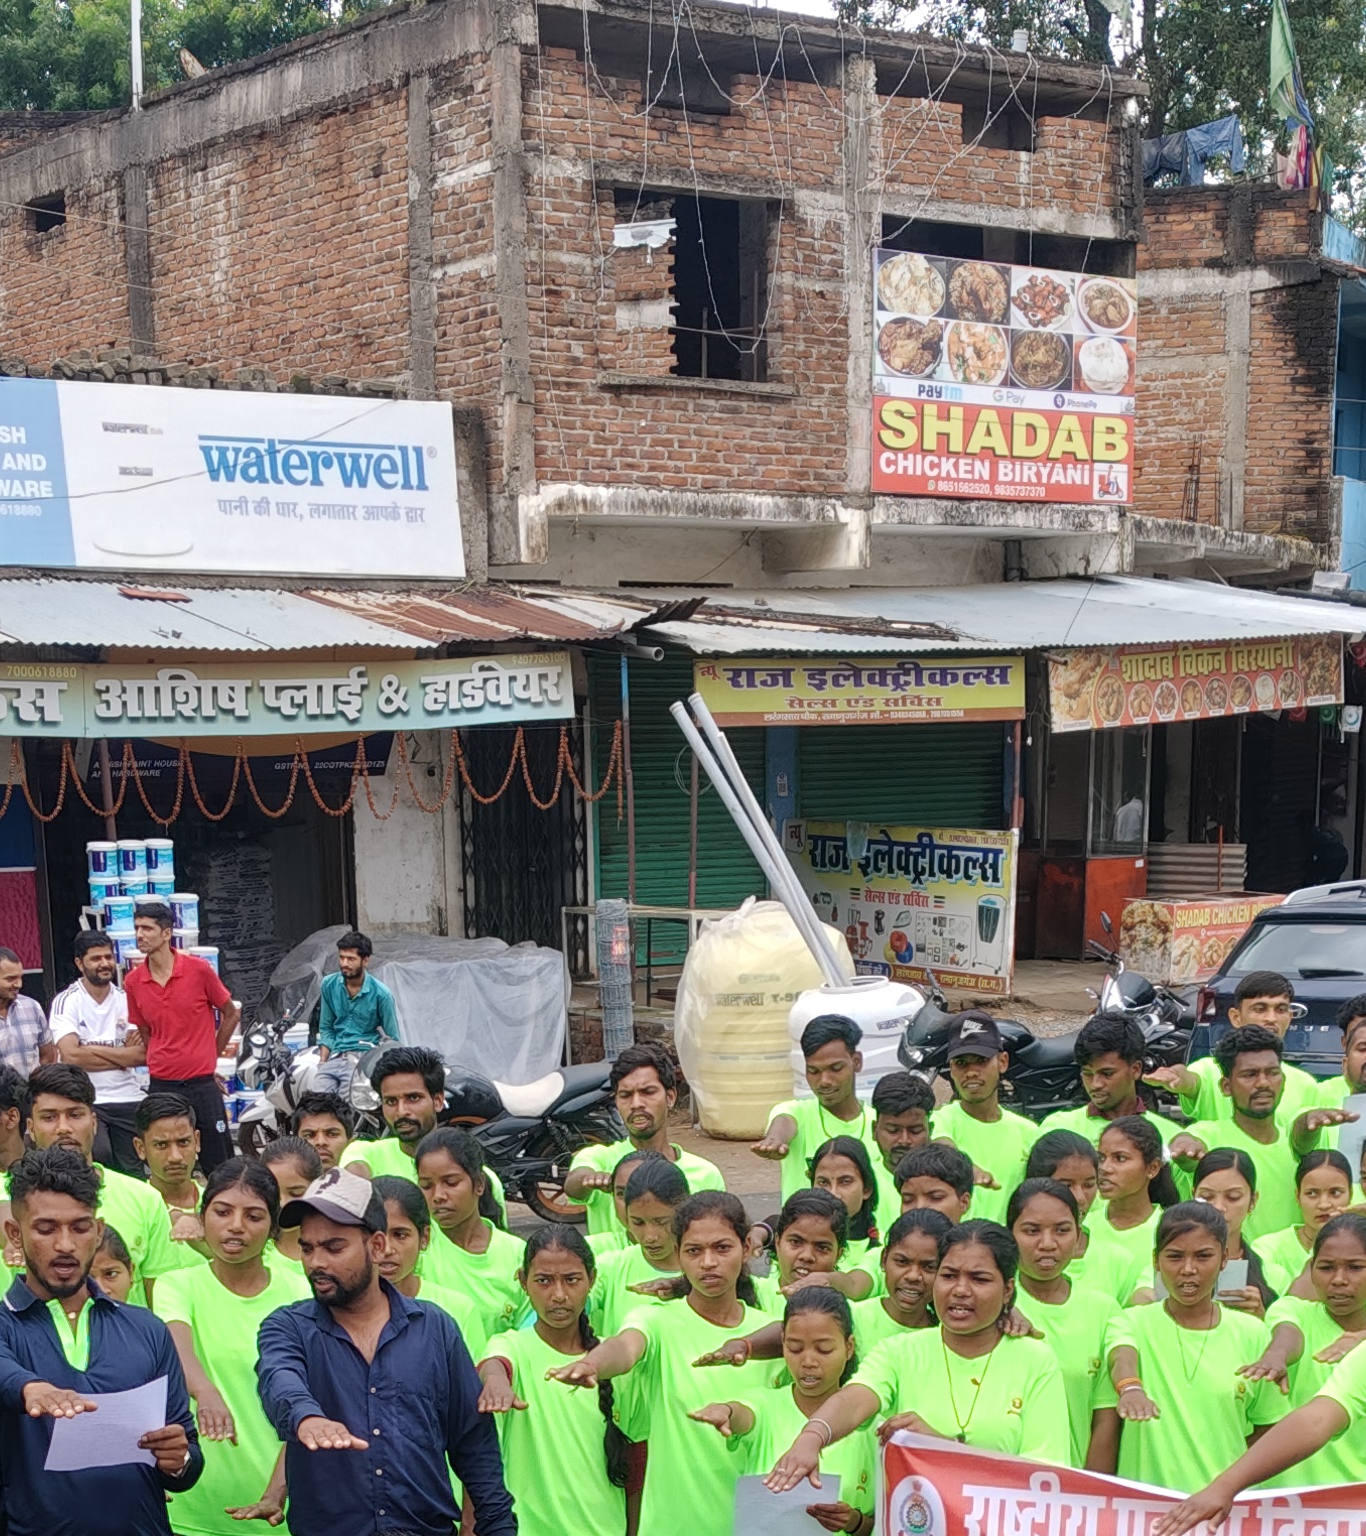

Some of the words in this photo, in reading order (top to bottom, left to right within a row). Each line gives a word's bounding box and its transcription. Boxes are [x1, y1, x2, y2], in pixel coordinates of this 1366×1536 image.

[878, 400, 1129, 463] SHADAB
[2, 453, 47, 471] AND
[198, 434, 429, 491] waterwell
[879, 451, 990, 480] CHICKEN
[997, 460, 1090, 486] BIRYANI
[217, 496, 249, 518] पानी
[253, 496, 272, 517] की
[309, 501, 357, 521] लगातार
[723, 667, 796, 689] राज
[1121, 650, 1176, 683] शादाब
[1177, 643, 1227, 678] चिकन
[94, 669, 252, 719] आशिष
[259, 666, 368, 720] प्लाई
[377, 673, 410, 715] &
[785, 695, 839, 709] सेल्स
[1176, 907, 1211, 928] SHADAB
[1212, 904, 1250, 925] CHICKEN
